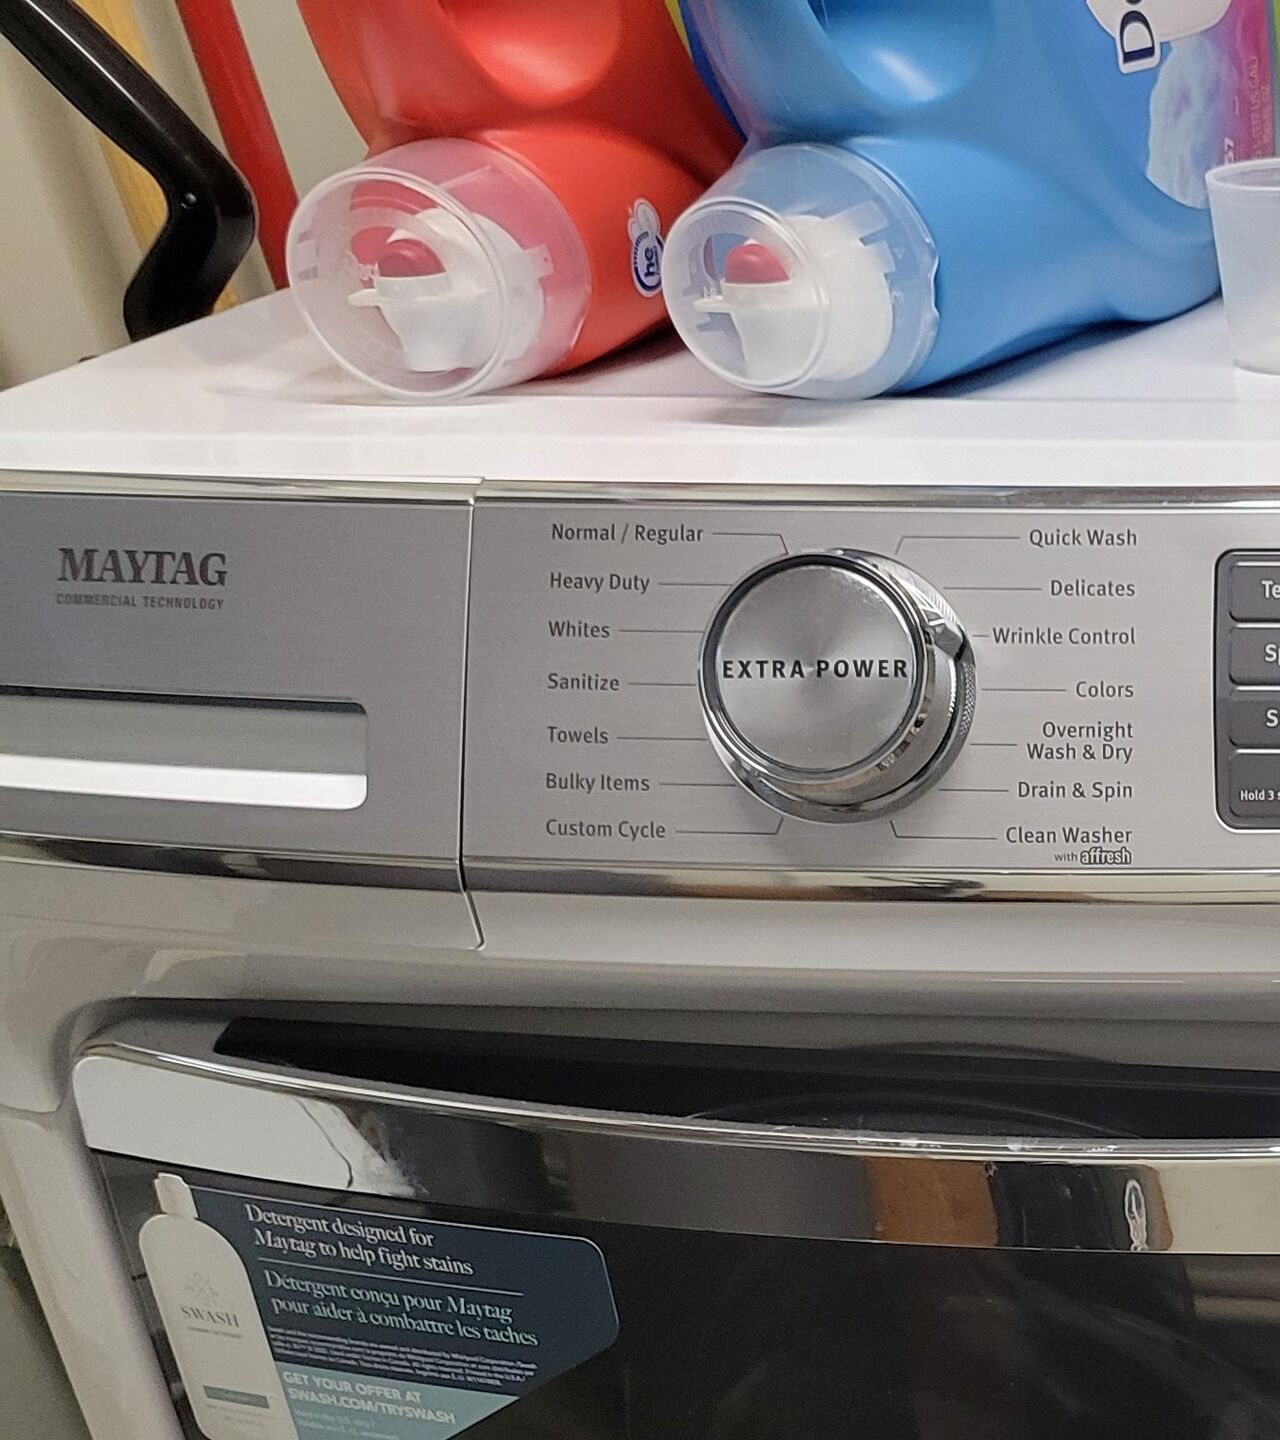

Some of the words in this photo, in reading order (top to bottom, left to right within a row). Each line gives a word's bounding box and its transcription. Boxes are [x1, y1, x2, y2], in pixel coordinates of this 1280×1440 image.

[551, 523, 616, 541] Normal
[634, 524, 704, 545] Regular
[1029, 528, 1083, 548] Quick
[1087, 528, 1137, 546] Wash
[57, 547, 228, 587] MAYTAG
[550, 572, 603, 593] Heavy
[610, 573, 650, 594] Duty
[1050, 578, 1136, 597] Delicates
[56, 593, 137, 607] COMMERCIAL
[143, 595, 225, 610] TECHNOLOGY
[549, 621, 610, 638] Whites
[992, 627, 1063, 644] Wrinkle
[1068, 627, 1136, 645] Control
[722, 660, 805, 679] EXTRA
[815, 659, 908, 678] POWER
[547, 673, 620, 691] Sanitize
[1076, 680, 1134, 698] Colors
[547, 726, 609, 744] Towels
[1042, 721, 1134, 742] Overnight
[1027, 743, 1076, 760] Wash
[1082, 744, 1096, 760] &
[1102, 743, 1133, 764] Dry
[546, 772, 596, 794] Bulky
[601, 774, 650, 791] Items
[1018, 781, 1066, 798] Drain
[1072, 782, 1086, 798] &
[1092, 781, 1133, 802] Spin
[1240, 789, 1265, 800] Hold
[546, 819, 612, 838] Custom
[618, 821, 666, 842] Cycle
[1006, 826, 1057, 843] Clean
[1062, 826, 1132, 843] Washer
[1054, 851, 1078, 862] with
[1079, 846, 1132, 865] affresh
[245, 1203, 330, 1234] Detergent
[331, 1217, 407, 1244] designed
[408, 1228, 434, 1247] for
[253, 1228, 318, 1258] Maytag
[319, 1240, 337, 1257] to
[338, 1241, 376, 1267] help
[378, 1247, 422, 1271] fight
[423, 1256, 474, 1275] stains
[264, 1269, 349, 1298] Détergent
[350, 1286, 400, 1308] conçu
[403, 1294, 443, 1312] pour
[447, 1296, 512, 1324] Maytag
[179, 1306, 240, 1328] SWASH
[271, 1297, 311, 1315] pour
[311, 1302, 354, 1322] aider
[356, 1306, 369, 1324] à
[369, 1312, 454, 1336] combattre
[457, 1320, 482, 1339] les
[484, 1325, 539, 1347] taches
[282, 1371, 310, 1385] GET
[311, 1375, 353, 1393] YOUR
[355, 1383, 401, 1400] OFFER
[405, 1391, 422, 1404] AT
[287, 1388, 457, 1425] SWASH.COM/TRYSWASH
